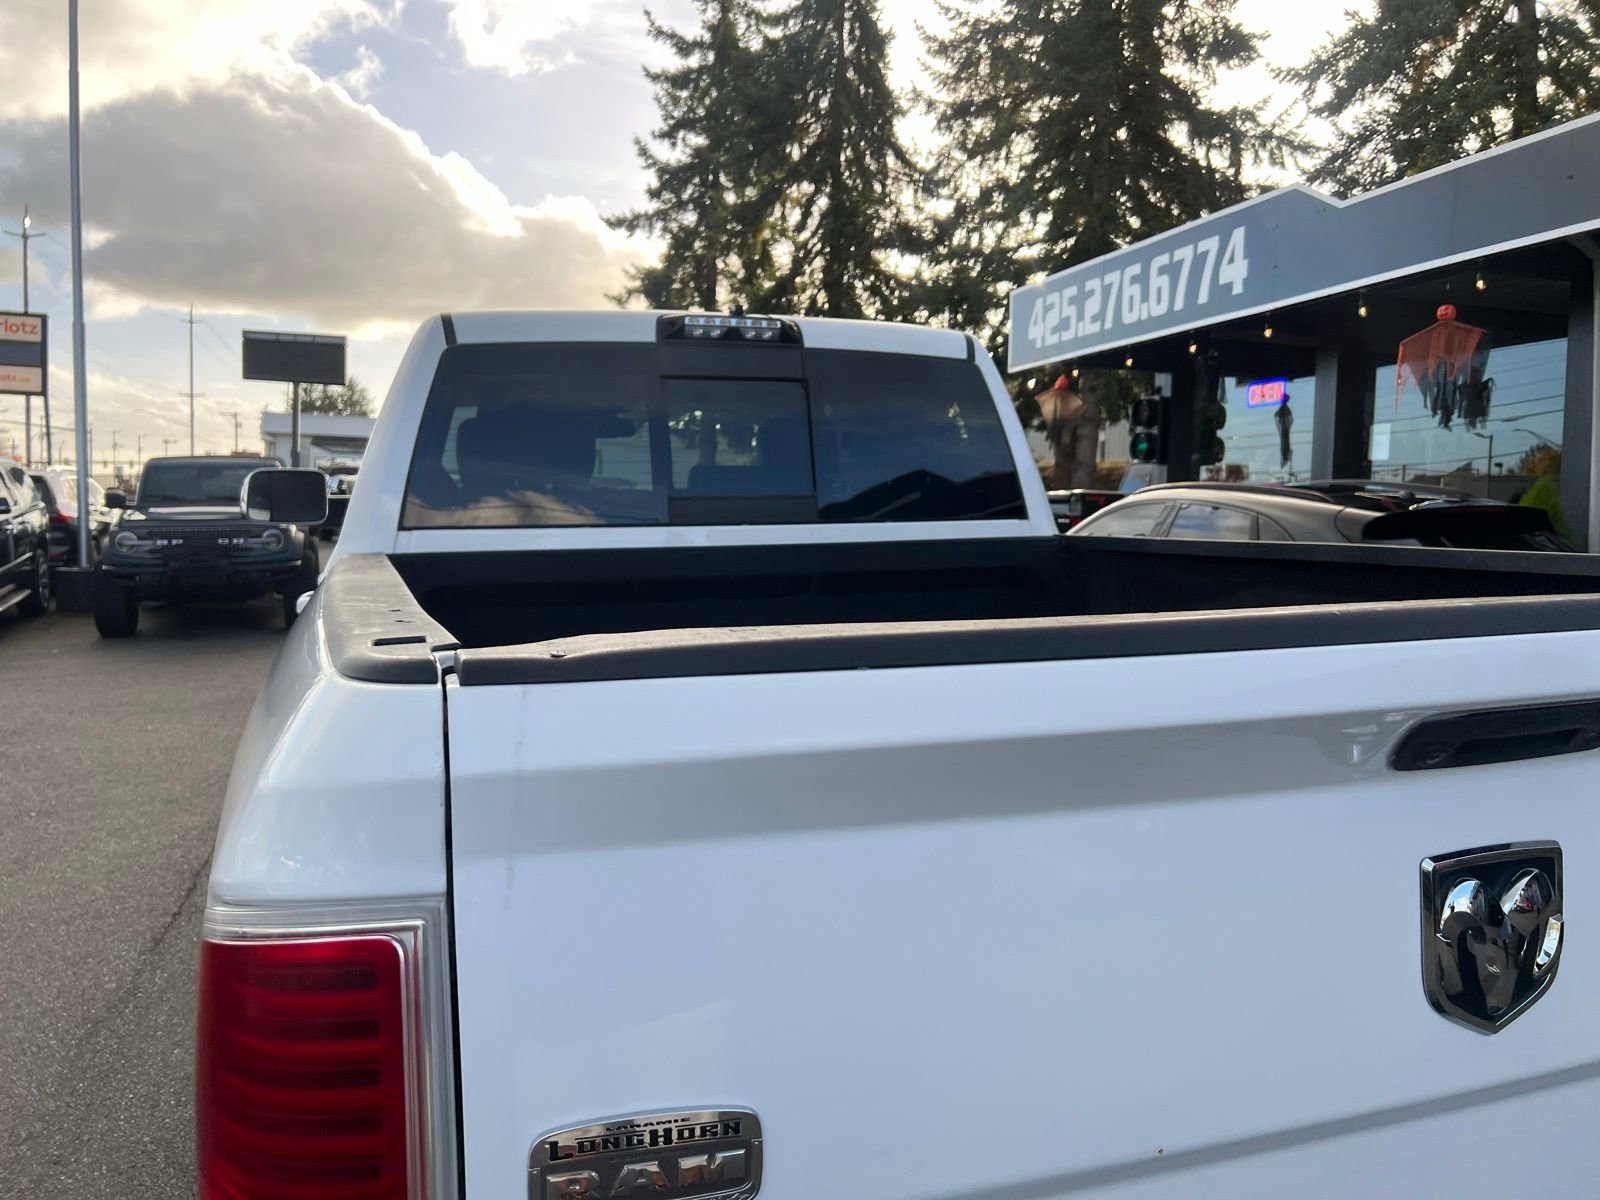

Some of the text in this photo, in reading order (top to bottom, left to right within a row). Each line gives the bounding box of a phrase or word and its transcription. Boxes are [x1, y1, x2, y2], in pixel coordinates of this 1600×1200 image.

[1028, 226, 1248, 349] 425.276.6774
[549, 1120, 742, 1161] LONGHORN
[547, 1149, 746, 1200] RAM
